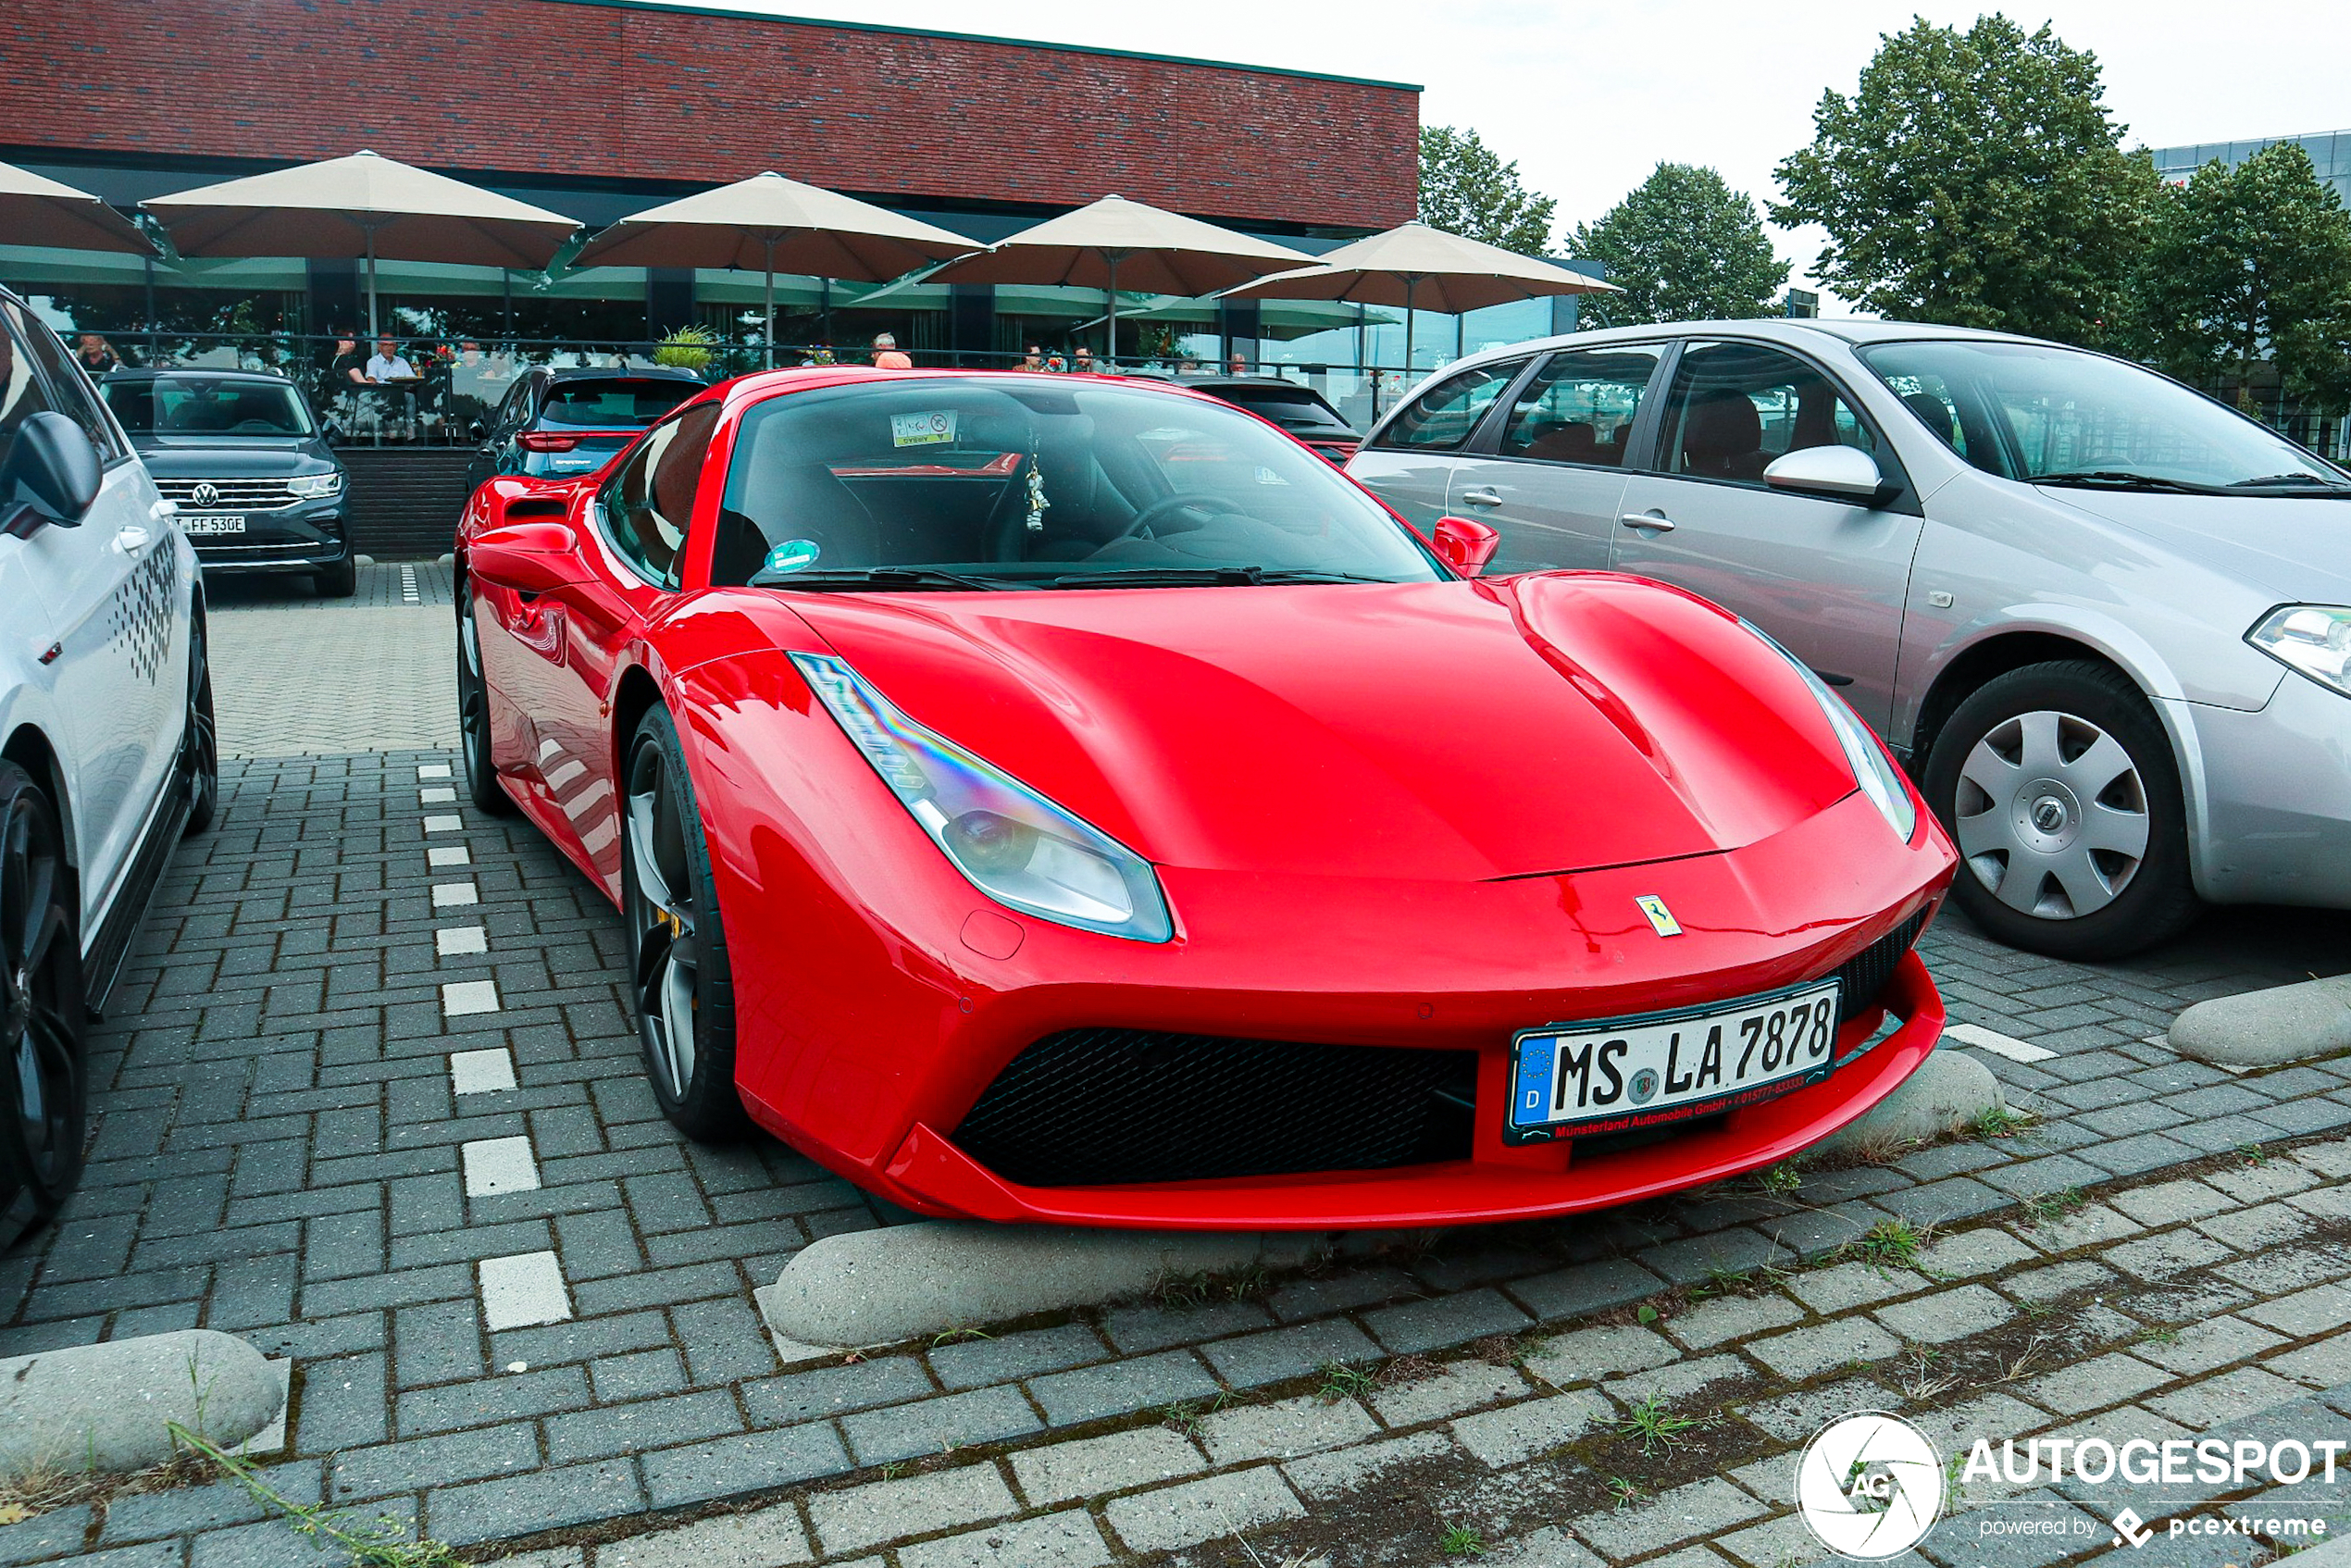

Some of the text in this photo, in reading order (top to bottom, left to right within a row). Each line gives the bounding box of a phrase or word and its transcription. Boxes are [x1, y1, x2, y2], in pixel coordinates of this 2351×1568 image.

[192, 518, 207, 531] FF
[211, 517, 243, 531] 530E
[786, 544, 798, 555] 4
[1555, 1039, 1628, 1111] MS
[1664, 1025, 1723, 1095] LA
[1735, 997, 1831, 1081] 7878
[1525, 1089, 1540, 1109] D
[1555, 1117, 1630, 1139] Münsterland
[1630, 1105, 1694, 1128] Automobile
[1695, 1099, 1726, 1115] GmbH
